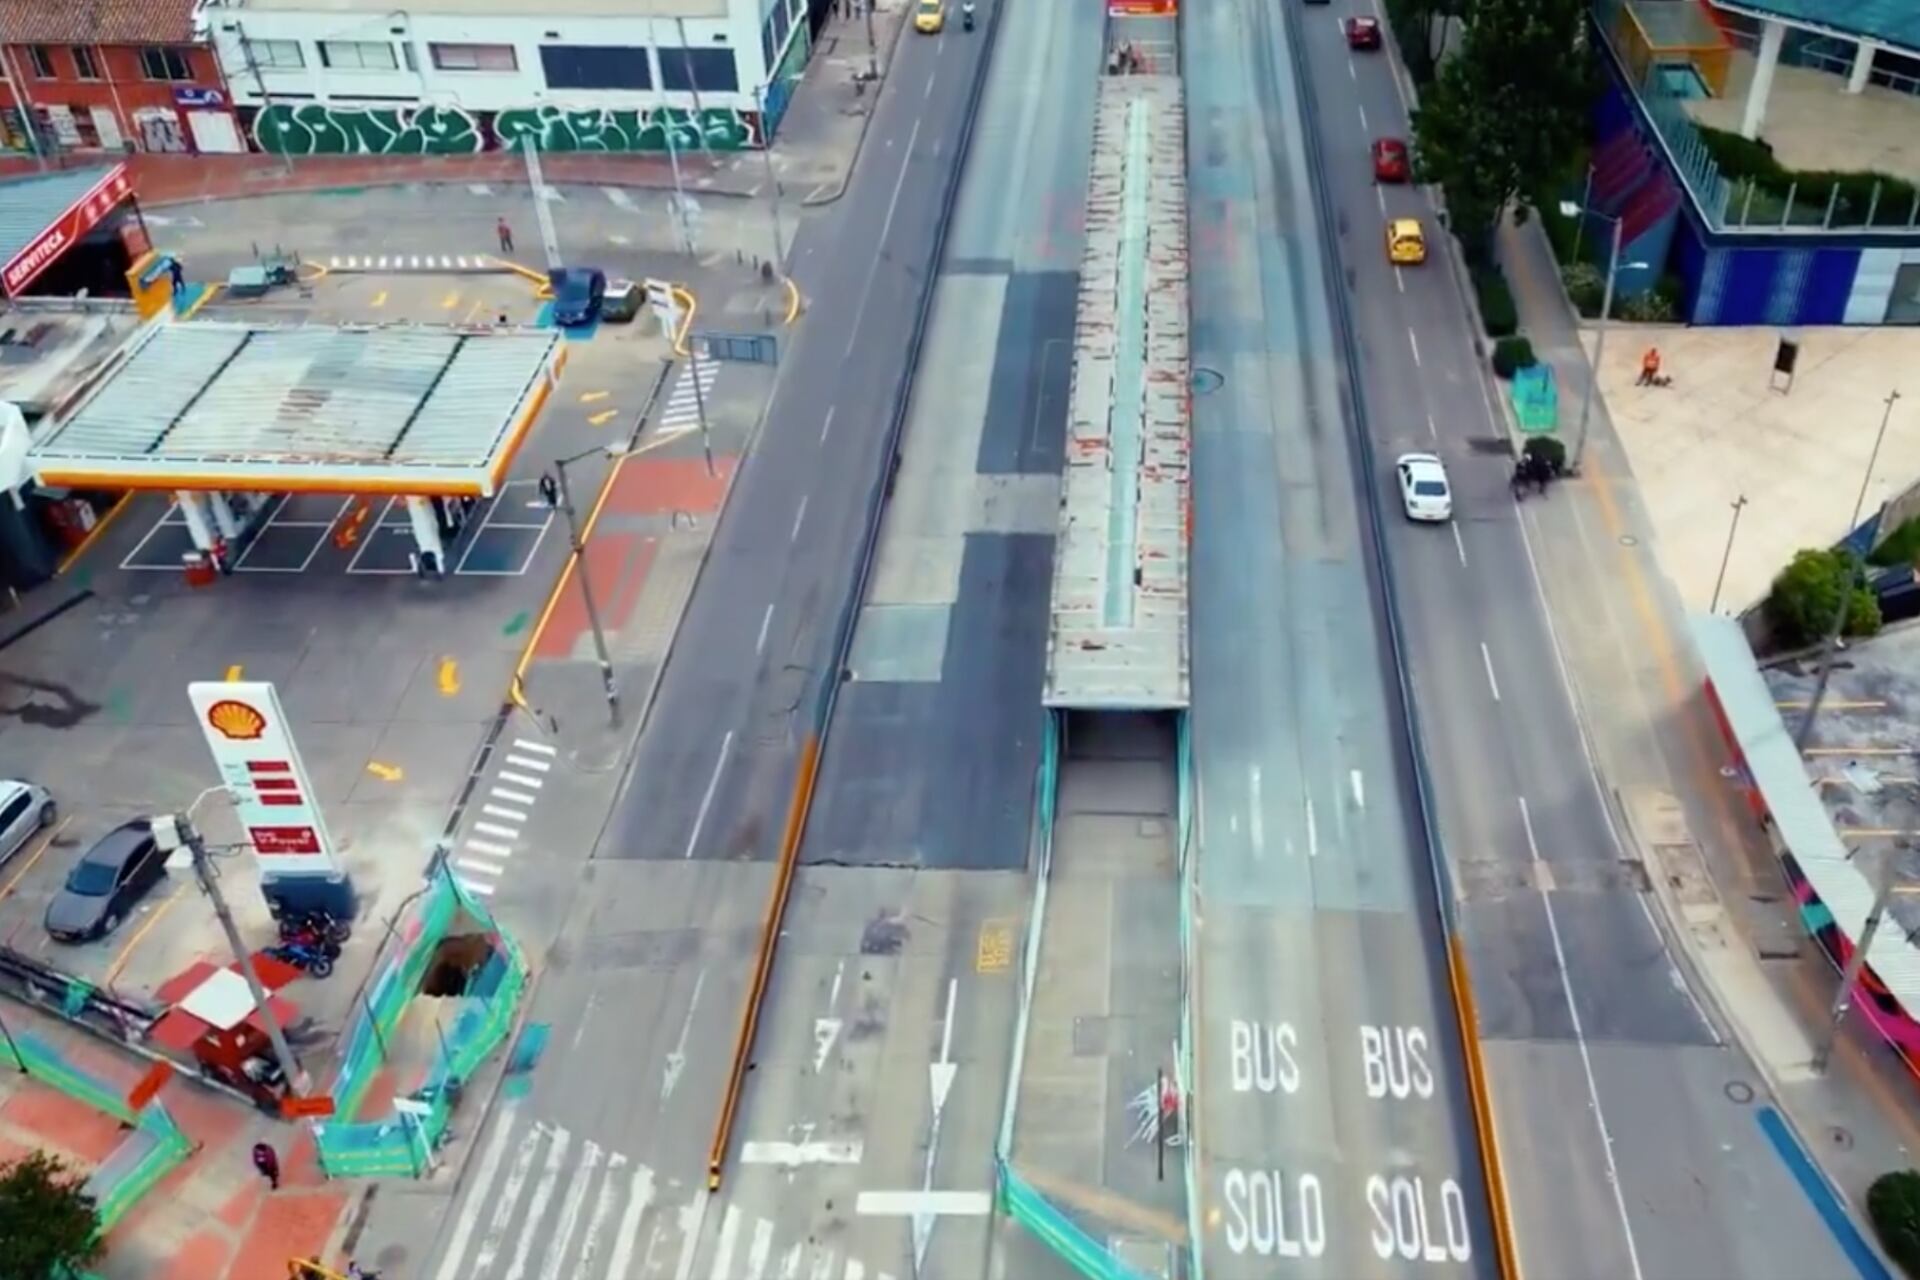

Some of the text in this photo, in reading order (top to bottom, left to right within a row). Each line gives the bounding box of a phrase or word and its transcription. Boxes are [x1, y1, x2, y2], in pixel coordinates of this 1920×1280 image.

[7, 229, 65, 286] SERVITECA
[1231, 1020, 1300, 1094] BUS
[1360, 1025, 1434, 1098] BUS
[1225, 1168, 1325, 1258] SOLO
[1367, 1174, 1471, 1262] SOLO
